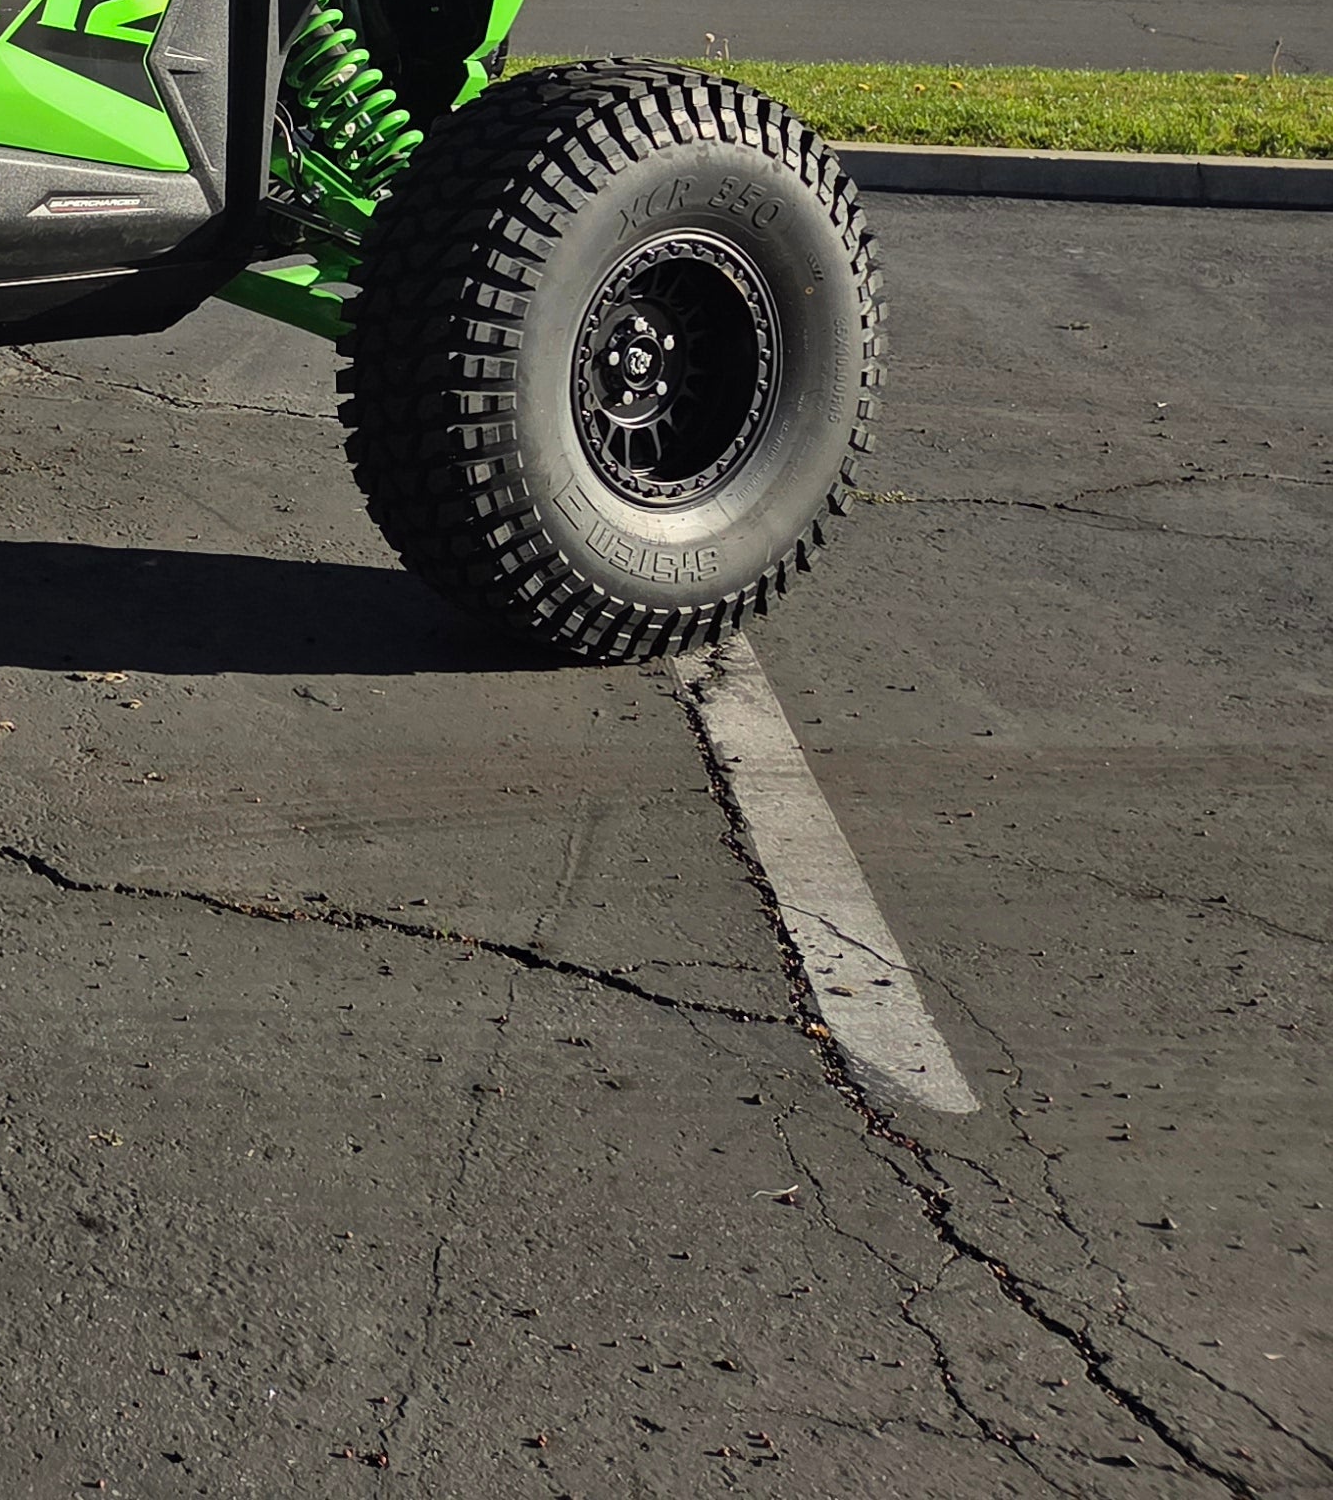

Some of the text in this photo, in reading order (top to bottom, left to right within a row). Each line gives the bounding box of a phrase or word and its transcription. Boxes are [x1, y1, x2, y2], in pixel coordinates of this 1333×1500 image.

[617, 175, 785, 242] XCR 350
[585, 520, 721, 584] SYSTEM
